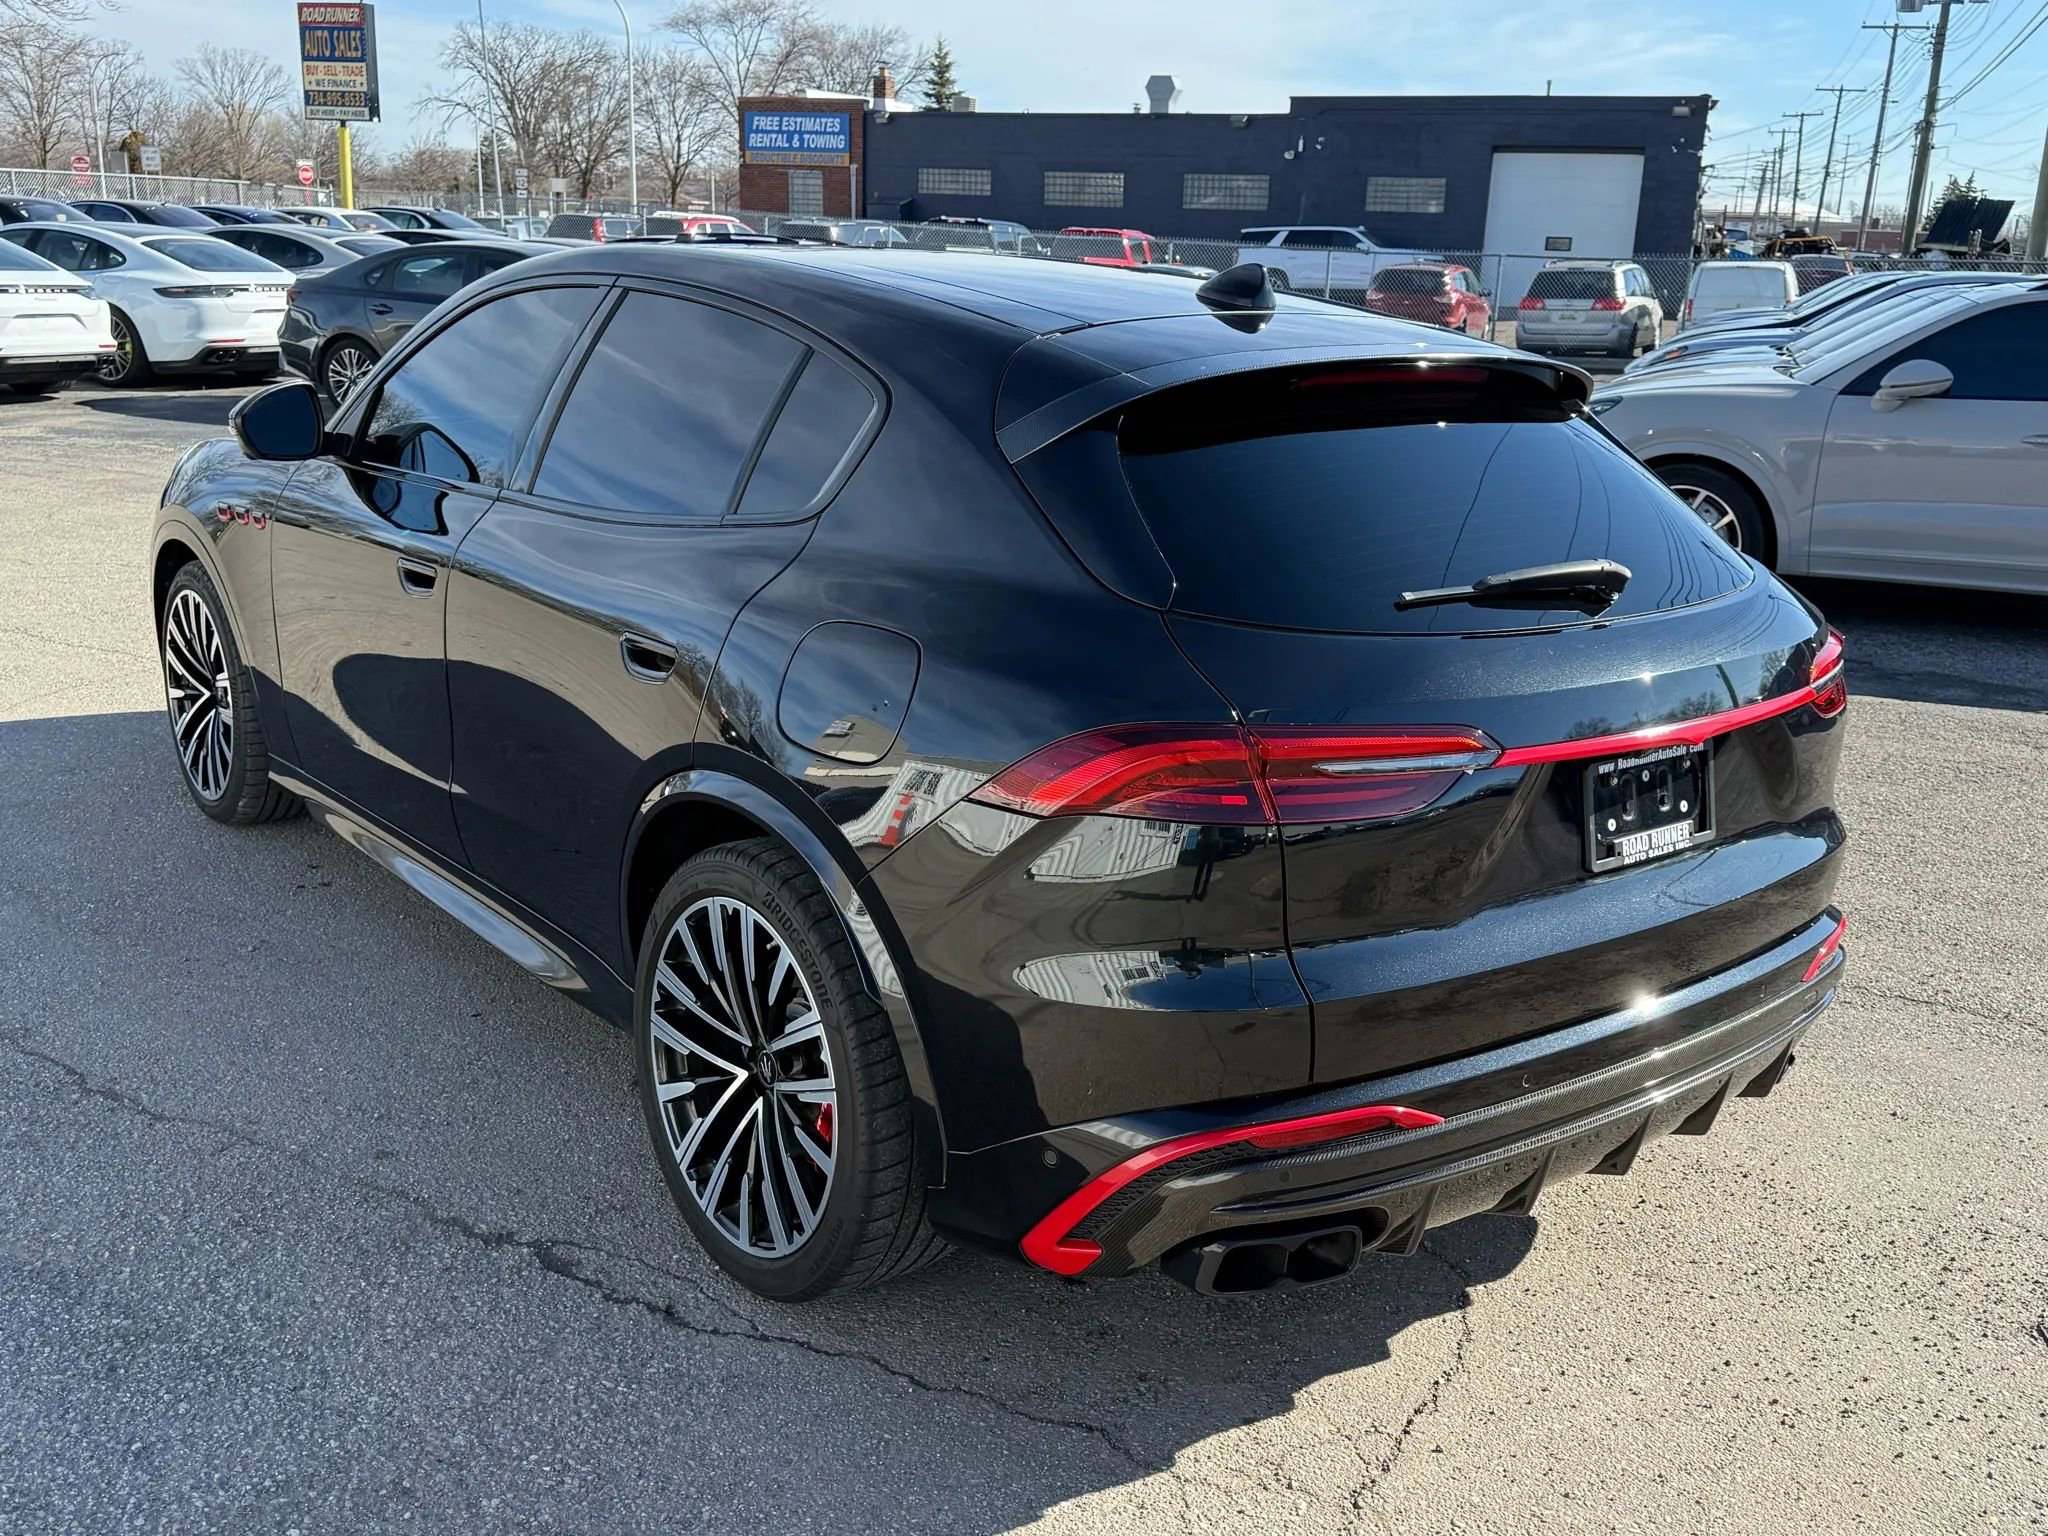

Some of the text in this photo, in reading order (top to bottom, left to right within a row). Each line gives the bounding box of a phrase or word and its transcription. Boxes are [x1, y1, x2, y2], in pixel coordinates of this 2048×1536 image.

[302, 7, 360, 23] ROAD RUNNER
[305, 30, 362, 58] AUTO SALES
[305, 65, 365, 77] BUY SELL TRADE
[315, 79, 358, 88] WE FINANCE
[752, 116, 841, 133] FREE ESTIMATES
[748, 133, 846, 149] RENTAL & TOWING
[1622, 823, 1690, 857] ROAD RUNNER
[1623, 851, 1647, 865] AUTO
[1647, 843, 1675, 861] SALES
[762, 890, 834, 1010] BRIDGESTONE
